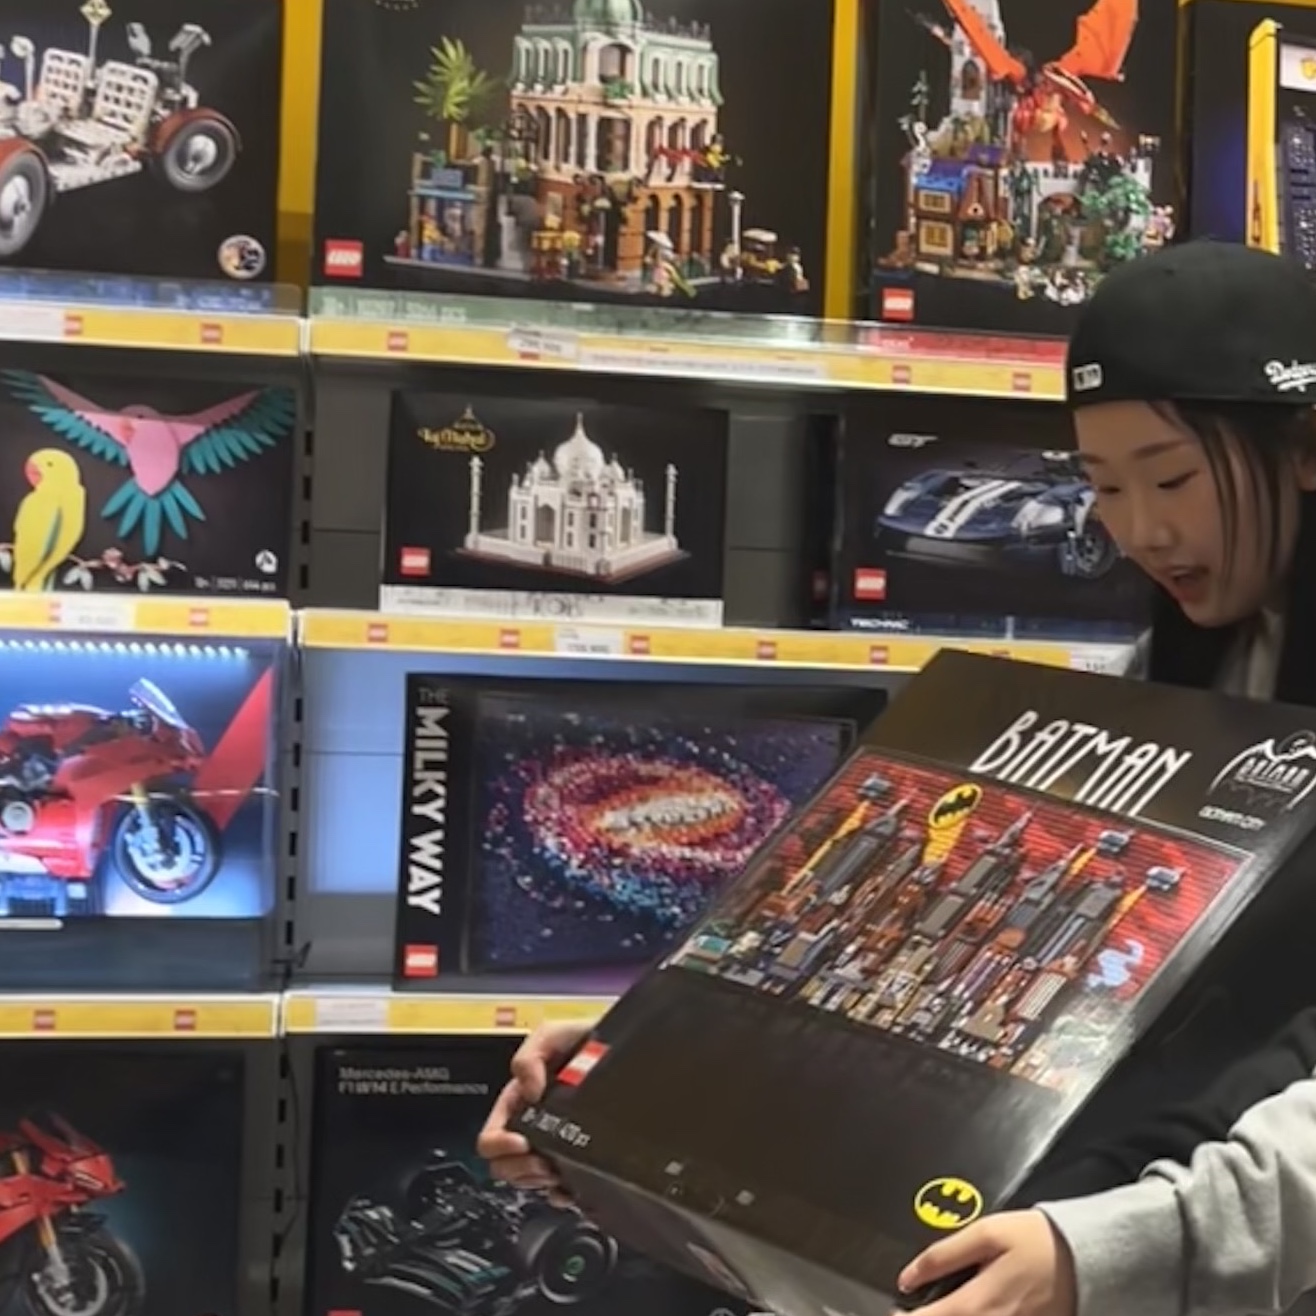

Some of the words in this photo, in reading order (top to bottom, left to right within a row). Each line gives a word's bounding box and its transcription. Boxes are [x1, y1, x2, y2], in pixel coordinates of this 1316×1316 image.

[419, 687, 448, 703] THE
[411, 706, 450, 823] MILKY
[970, 709, 1193, 819] BATMAN
[406, 829, 446, 915] WAY
